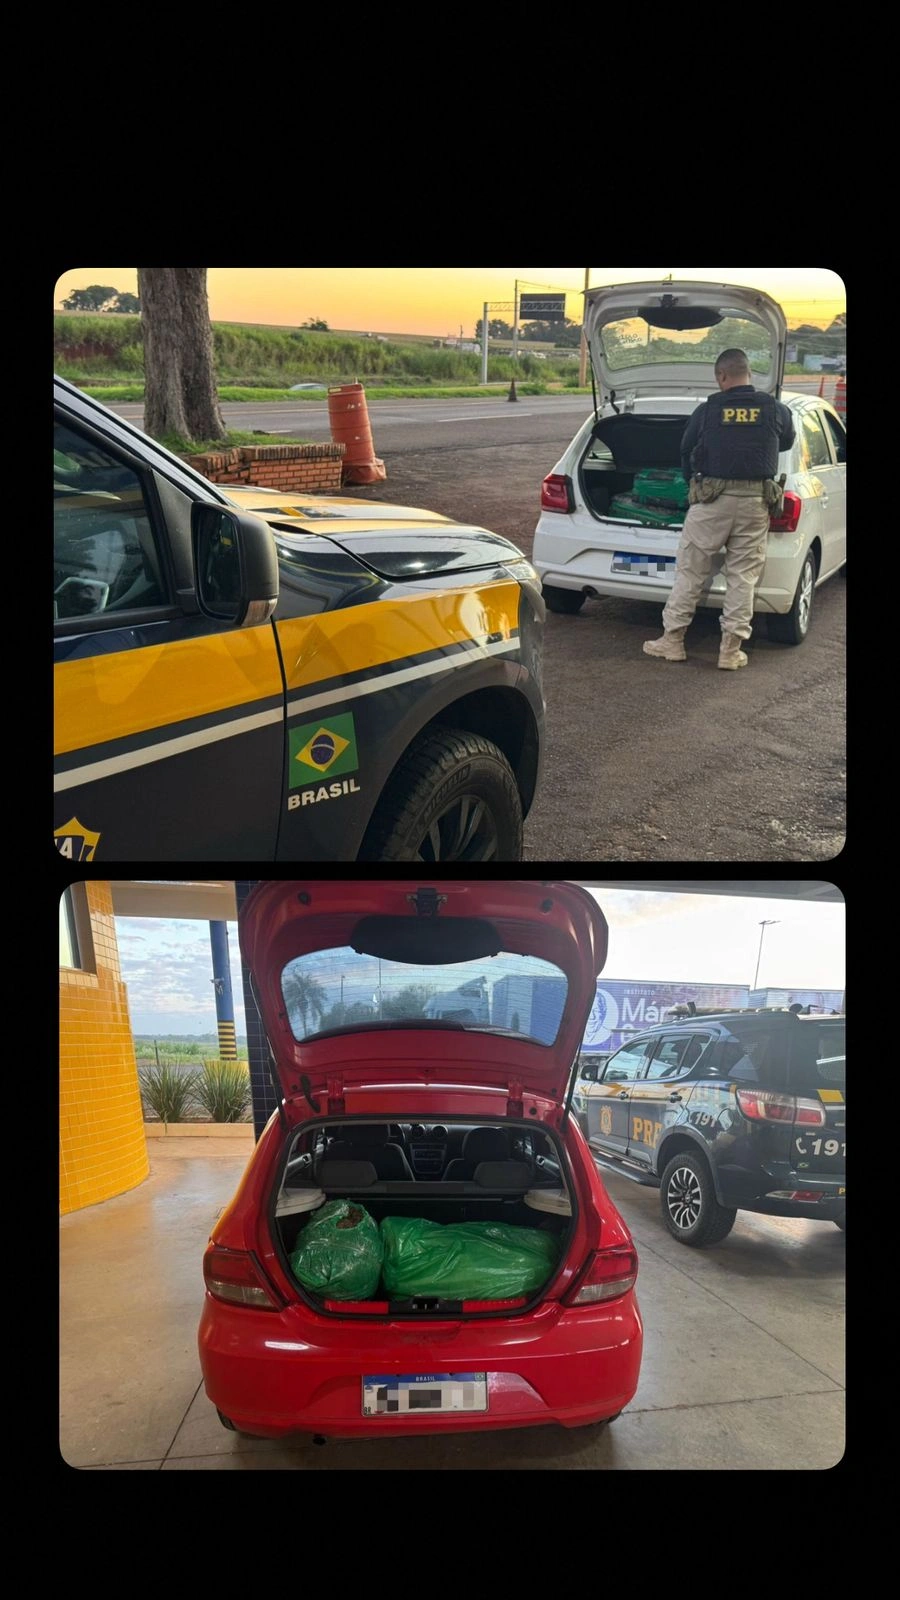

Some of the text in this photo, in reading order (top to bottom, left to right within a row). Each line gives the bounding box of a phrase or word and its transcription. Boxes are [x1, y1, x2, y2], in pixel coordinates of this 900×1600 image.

[723, 408, 760, 422] PRF
[288, 779, 361, 810] BRASIL
[694, 1111, 718, 1128] 191
